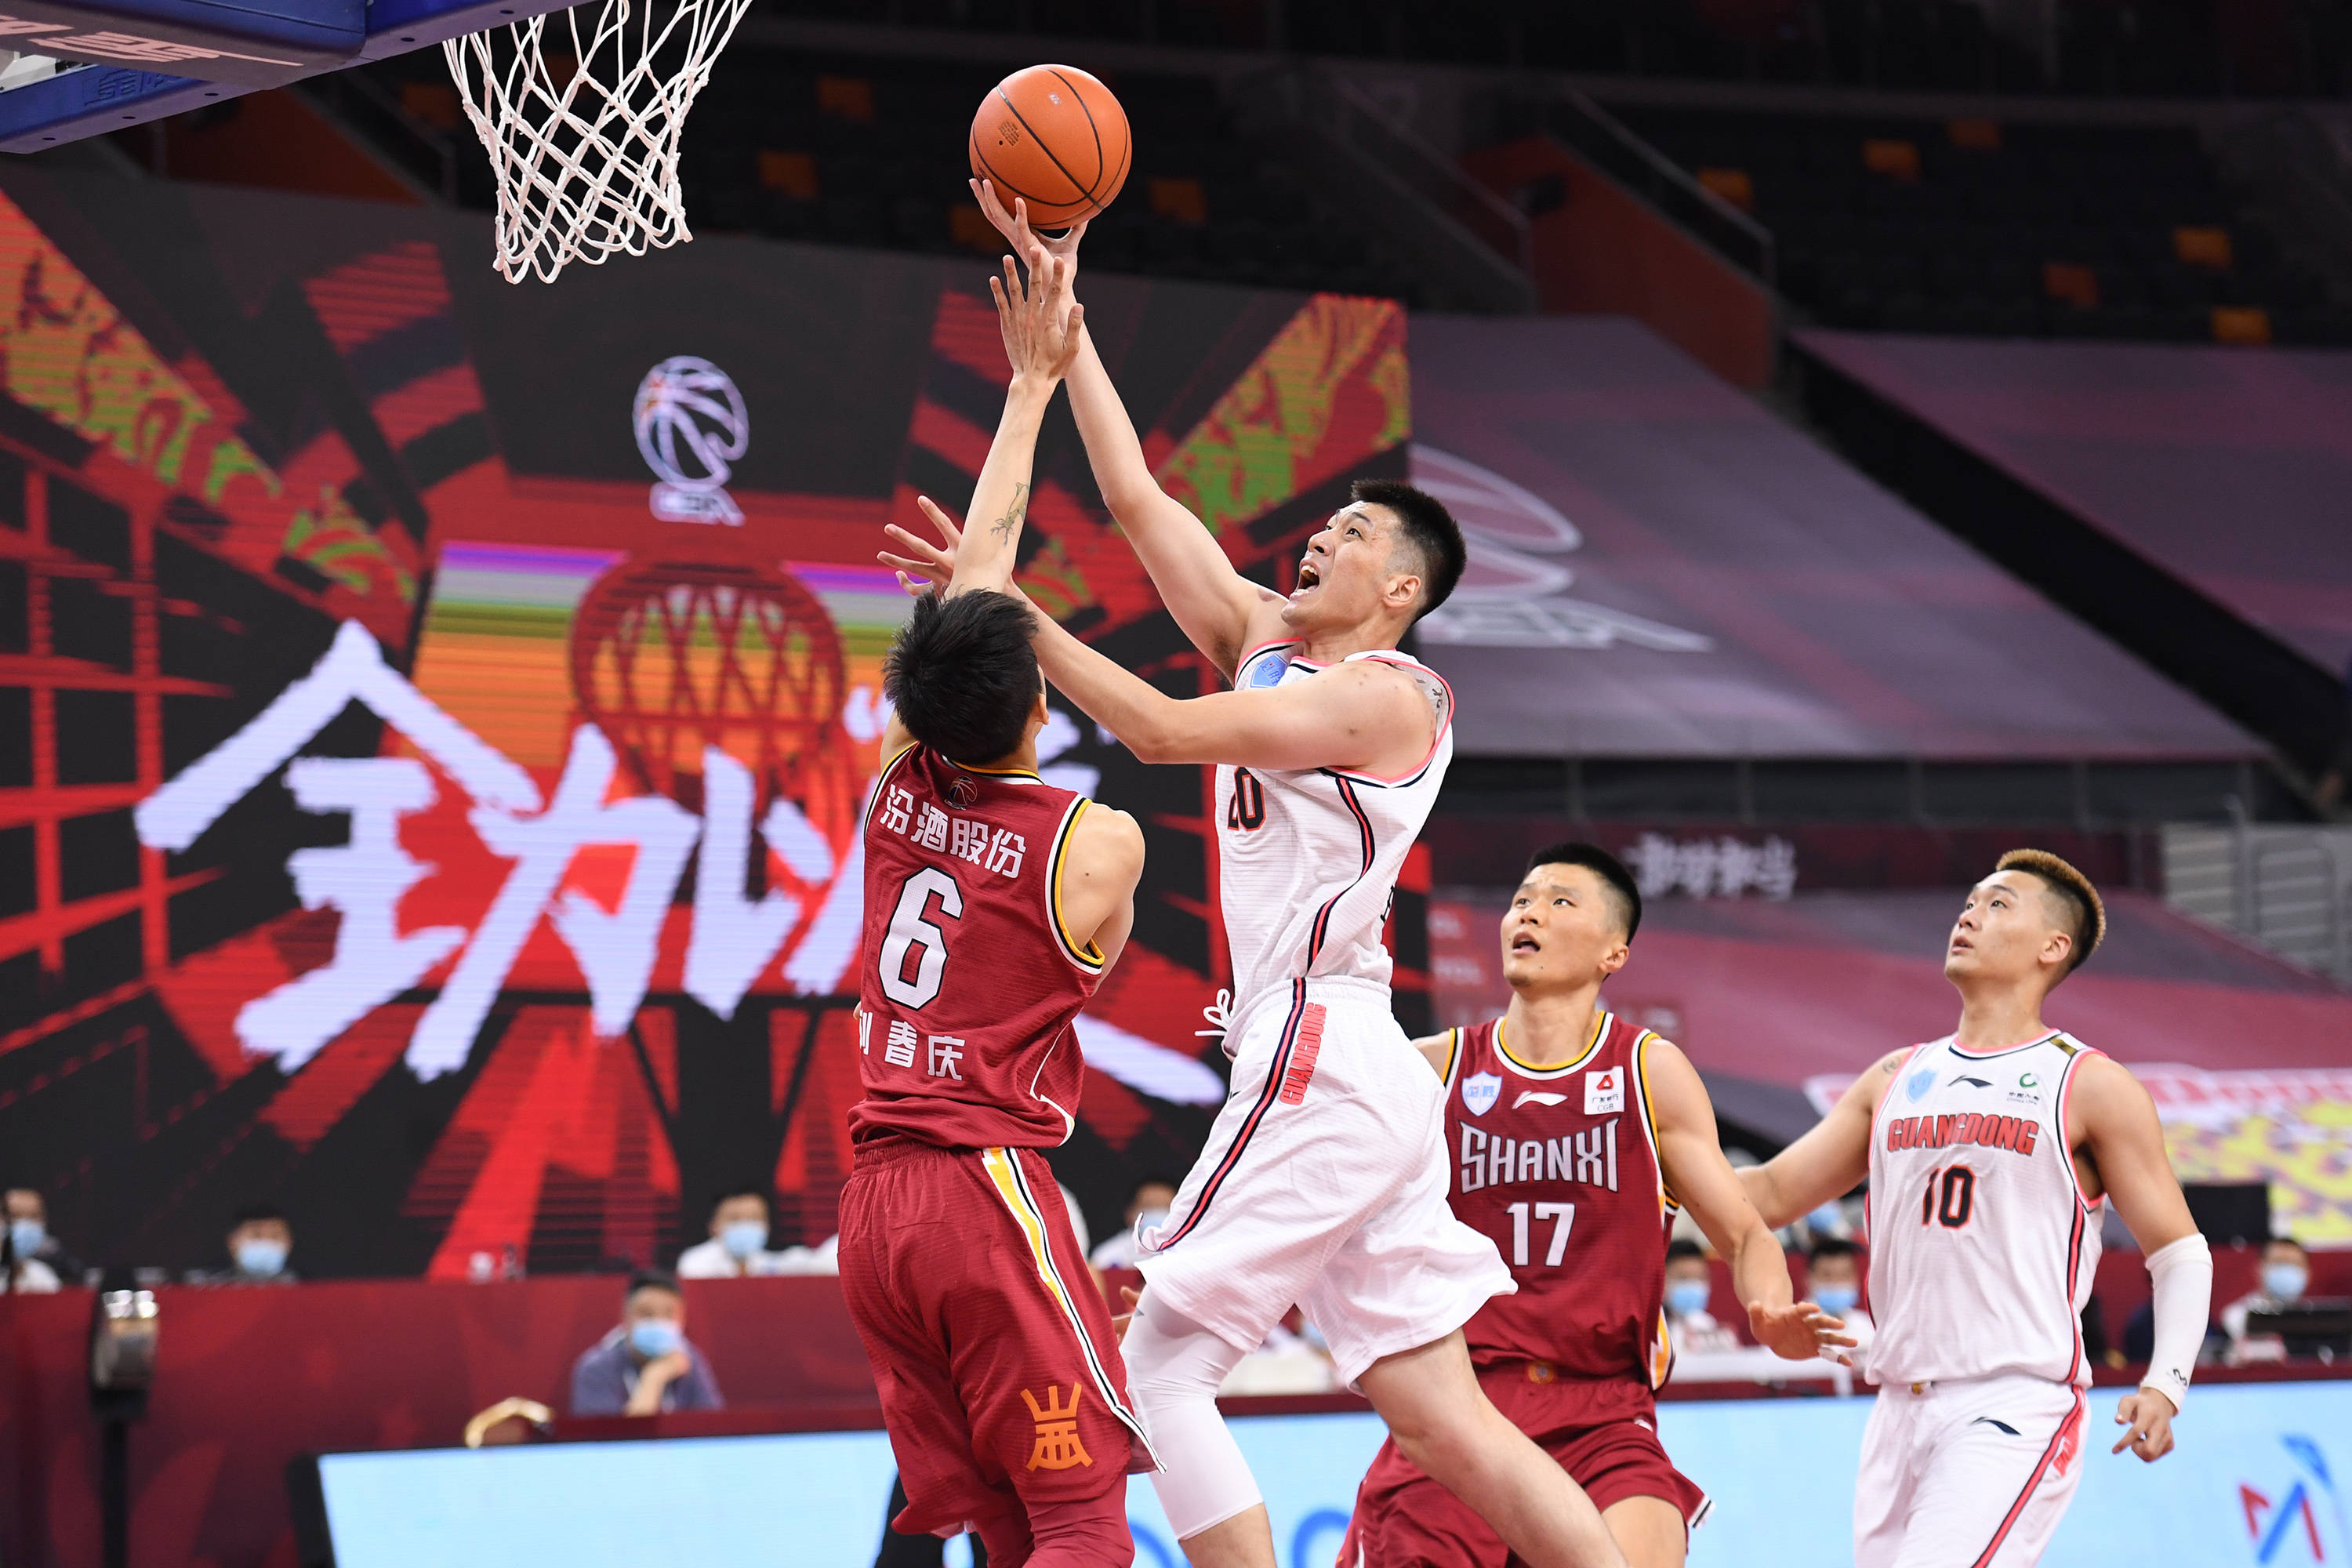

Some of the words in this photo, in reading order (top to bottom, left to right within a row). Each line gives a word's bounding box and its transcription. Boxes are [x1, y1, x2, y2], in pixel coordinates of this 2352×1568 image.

[880, 784, 1027, 879] 汾酒股份
[878, 865, 964, 1011] 6
[1279, 1001, 1327, 1105] GUANGDONG
[1459, 1115, 1621, 1195] SHANXI
[1887, 1112, 2040, 1156] GUANGDONG
[1505, 1202, 1576, 1267] 17
